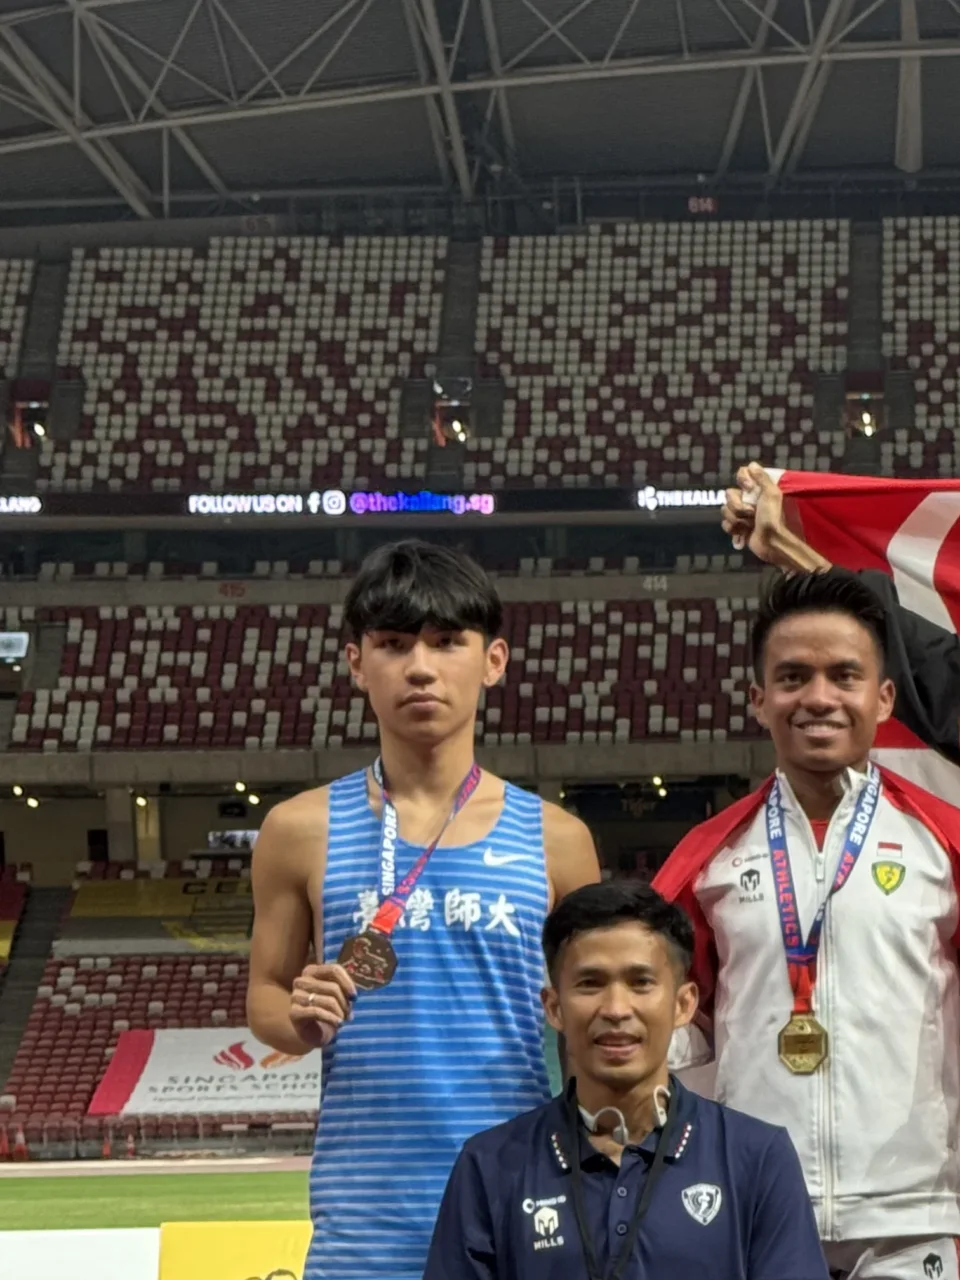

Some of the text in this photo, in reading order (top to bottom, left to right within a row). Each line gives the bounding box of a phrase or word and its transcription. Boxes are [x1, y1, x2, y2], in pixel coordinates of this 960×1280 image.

[188, 495, 251, 513] FOLLOW
[252, 495, 275, 513] US
[276, 495, 302, 513] ON
[381, 804, 398, 896] SINGAPORE
[773, 849, 800, 947] ATHLETICS
